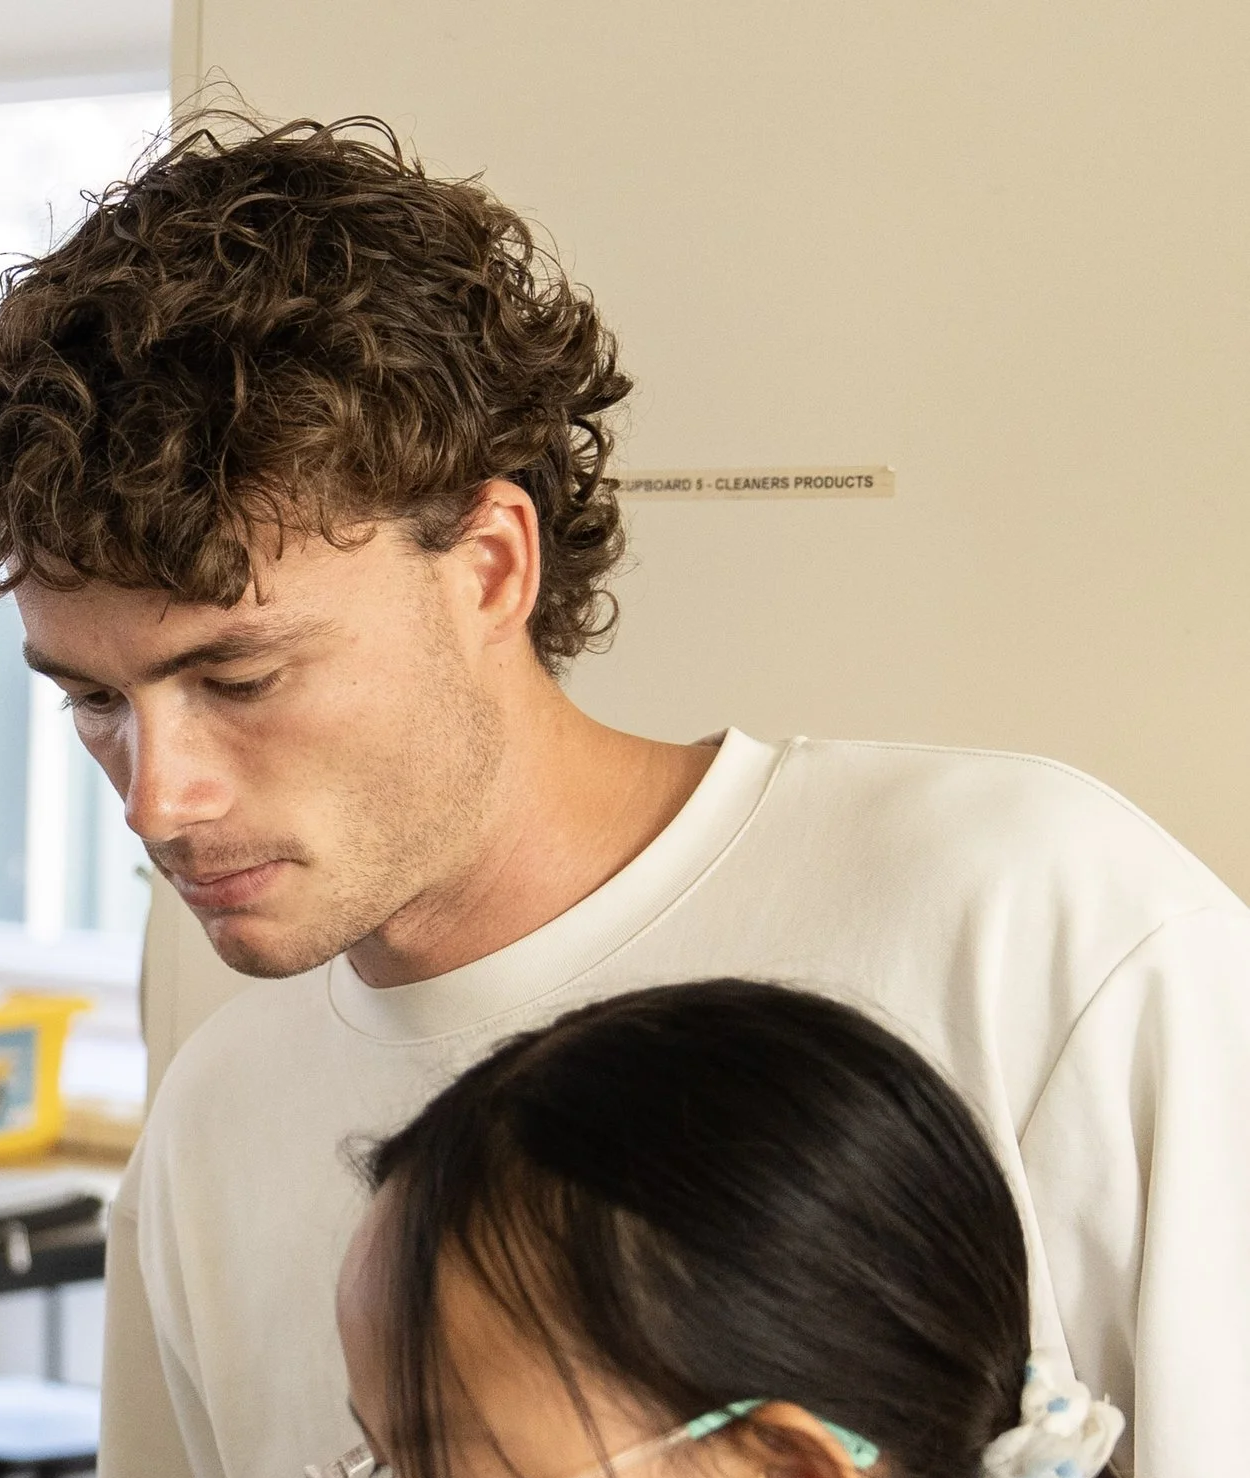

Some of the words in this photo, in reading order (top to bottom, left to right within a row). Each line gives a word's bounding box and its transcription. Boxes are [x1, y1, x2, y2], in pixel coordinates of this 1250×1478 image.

[695, 477, 704, 491] 5
[714, 477, 790, 491] CLEANERS
[794, 475, 874, 490] PRODUCTS
